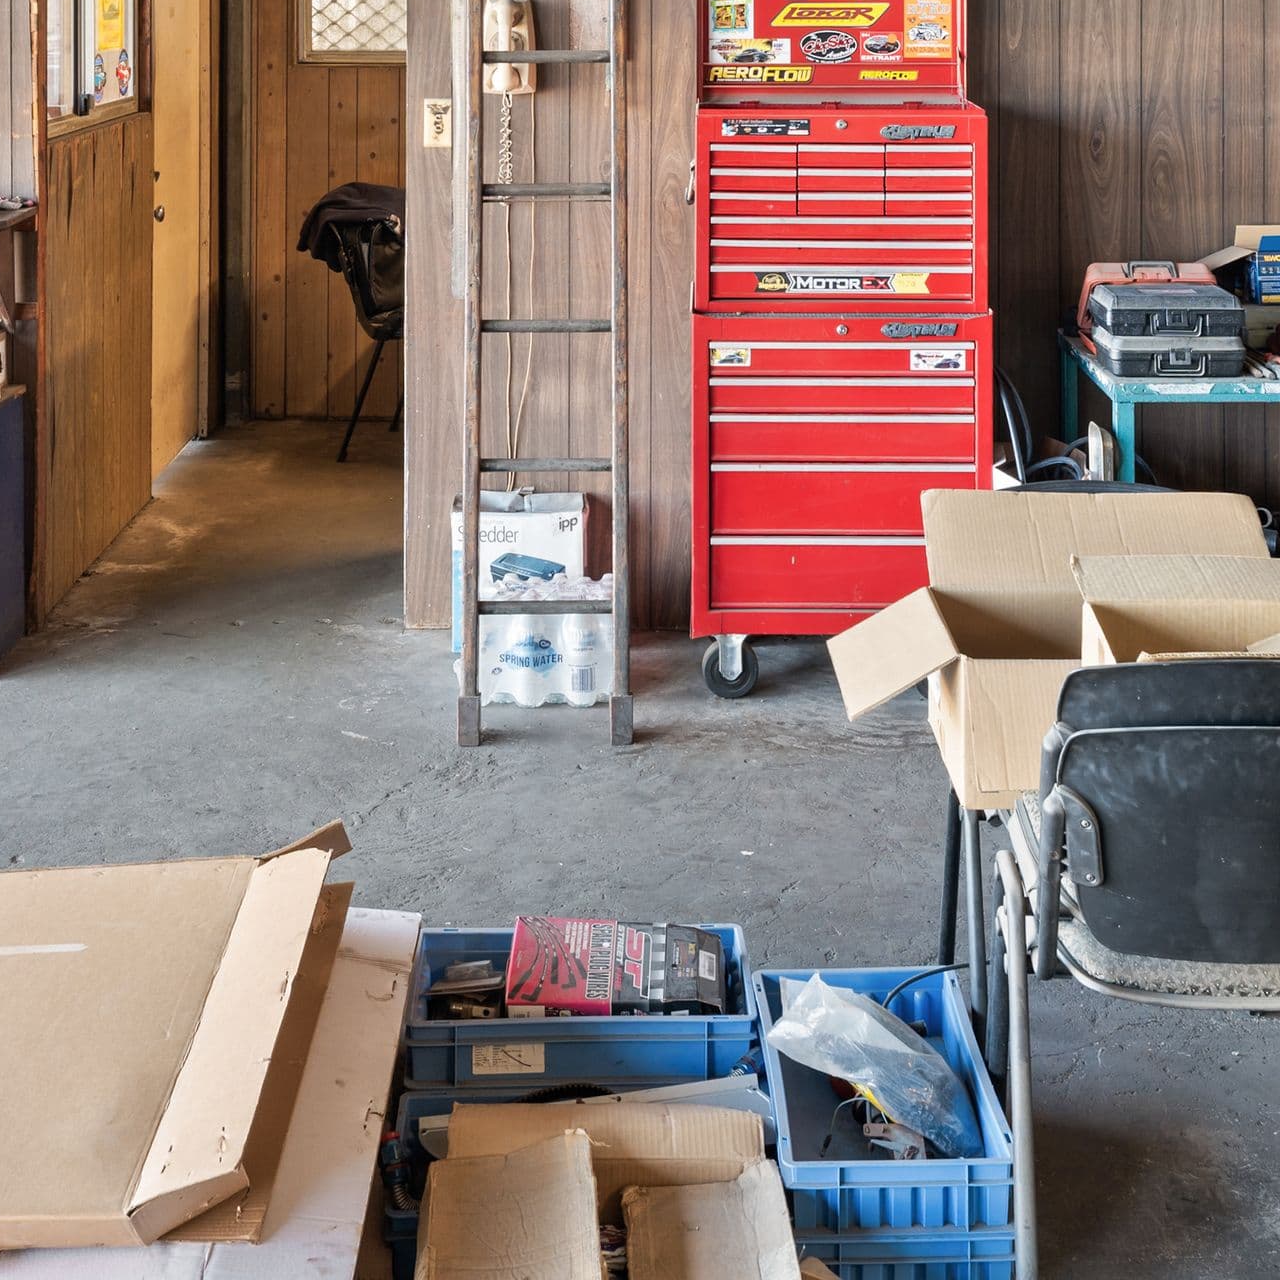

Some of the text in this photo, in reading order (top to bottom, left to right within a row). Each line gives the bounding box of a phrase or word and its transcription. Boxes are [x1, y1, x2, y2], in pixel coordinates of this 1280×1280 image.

[709, 66, 812, 82] AEROFLOW
[558, 516, 578, 532] ipp
[458, 526, 519, 544] Sedder
[499, 654, 563, 668] SPRING WATER
[585, 923, 613, 1000] SPARK PLUG WIRES
